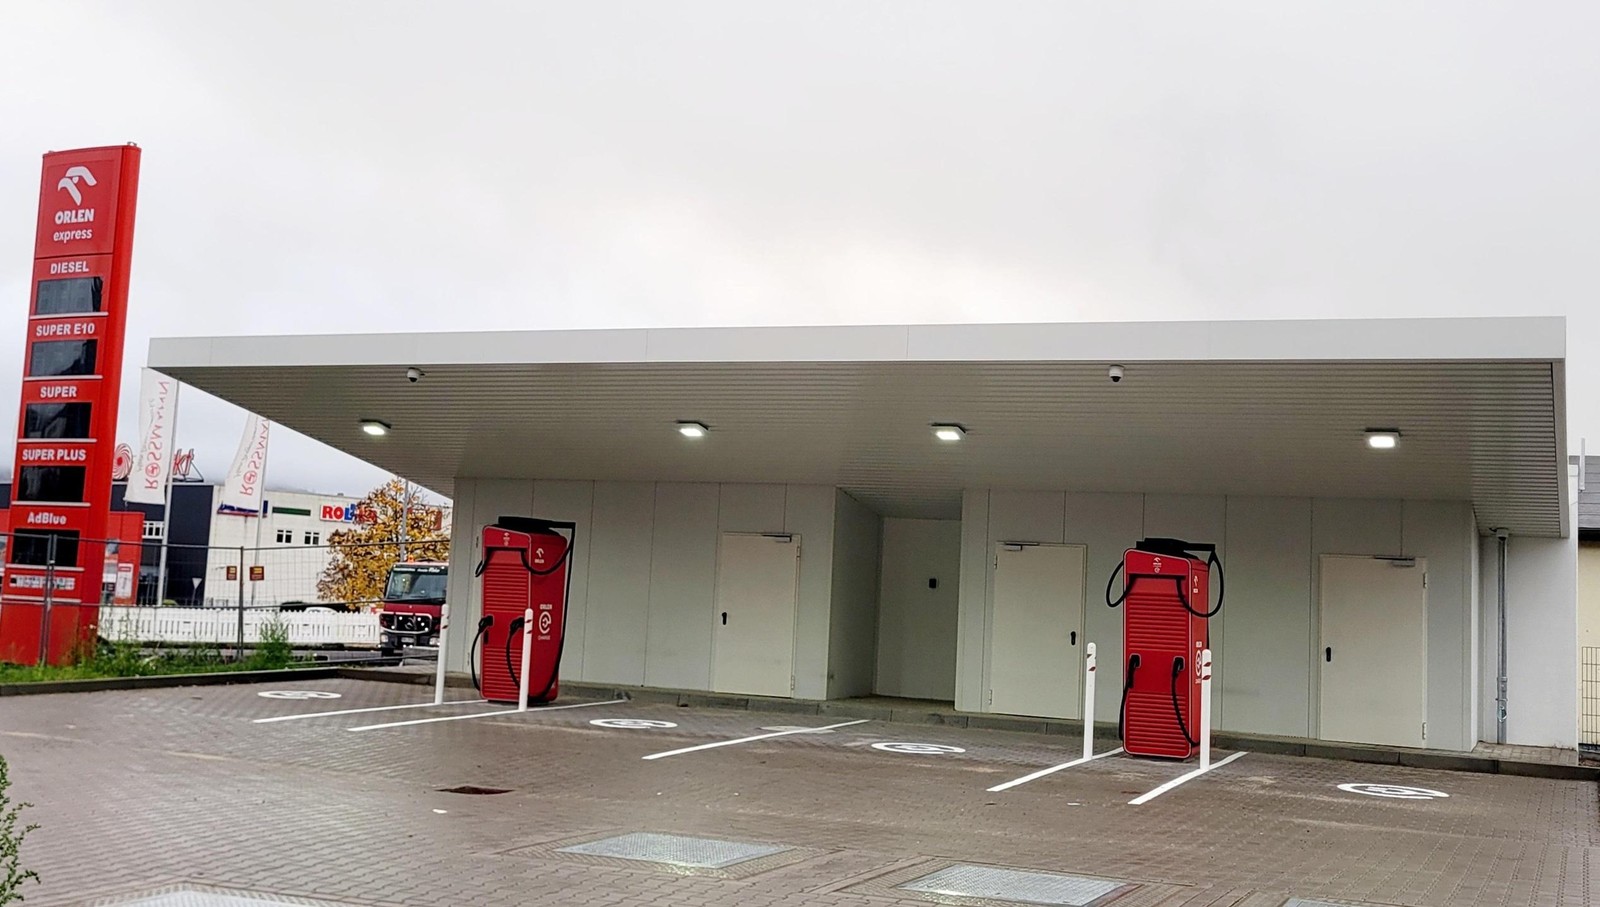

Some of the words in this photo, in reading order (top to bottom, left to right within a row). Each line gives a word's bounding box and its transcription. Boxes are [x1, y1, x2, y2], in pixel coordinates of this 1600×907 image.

[55, 208, 94, 224] ORLEN
[53, 229, 92, 243] express
[50, 261, 89, 274] DIESEL
[36, 324, 71, 336] SUPER
[73, 323, 95, 335] E10
[40, 386, 77, 398] SUPER
[22, 449, 55, 461] SUPER
[56, 449, 86, 461] PLUS
[27, 512, 67, 525] AdBlue
